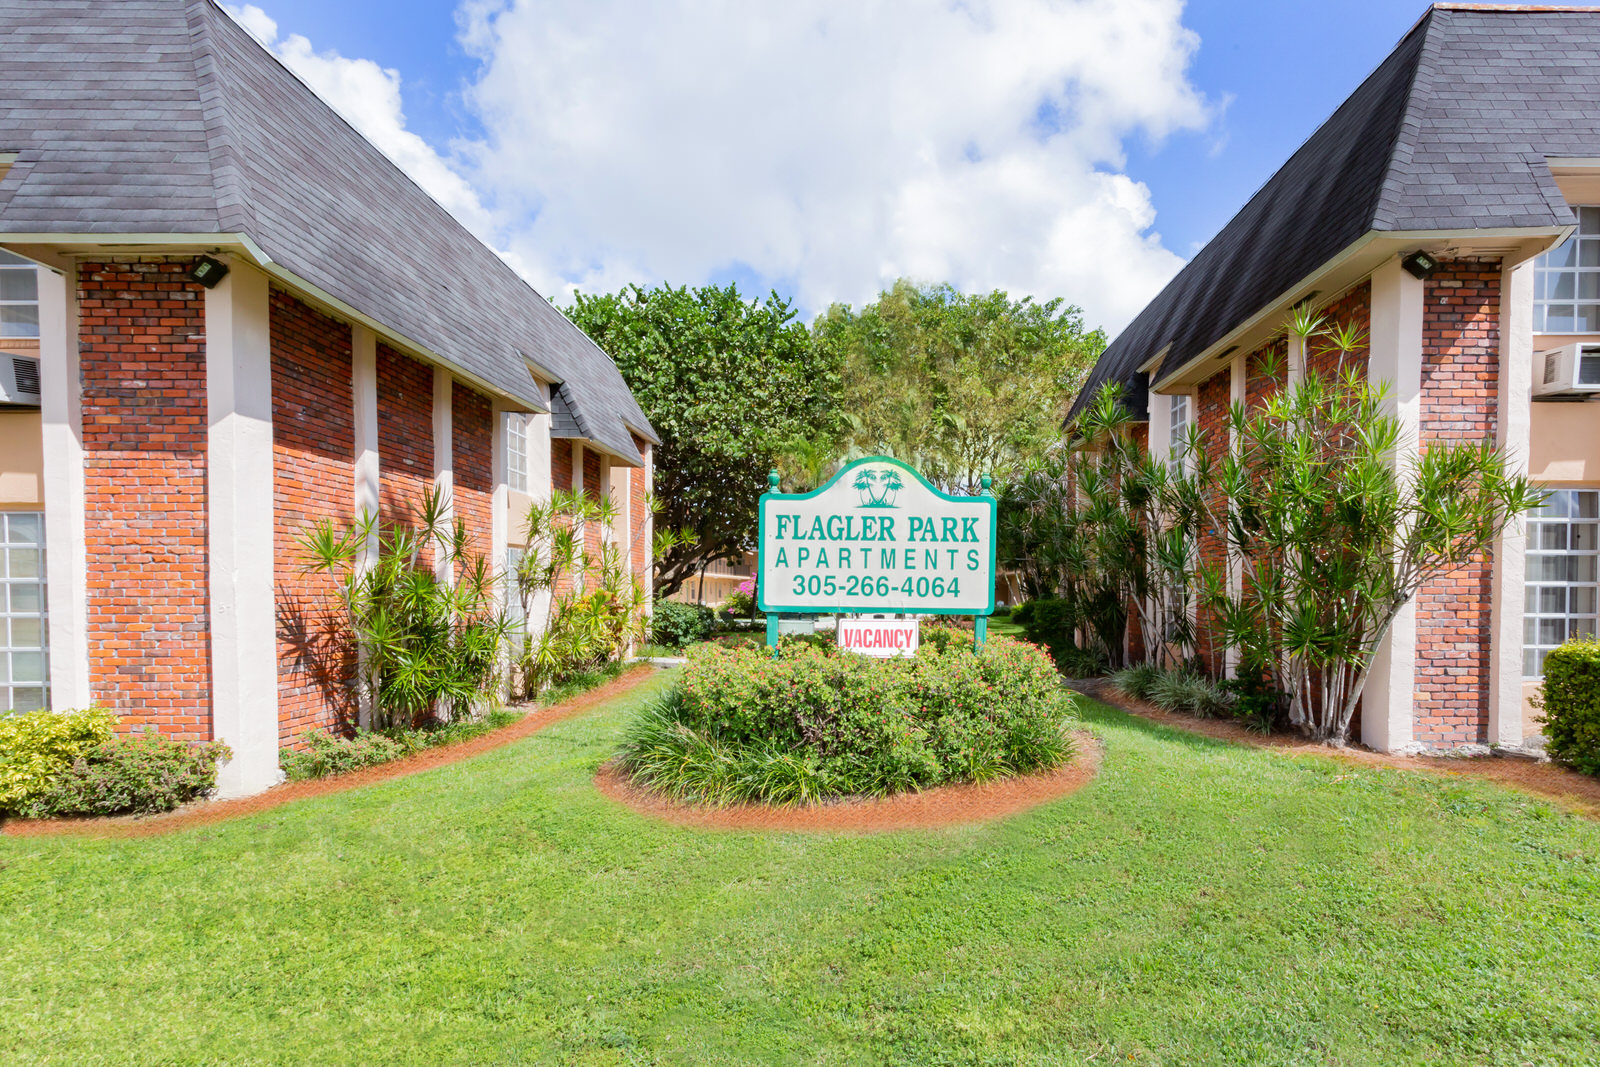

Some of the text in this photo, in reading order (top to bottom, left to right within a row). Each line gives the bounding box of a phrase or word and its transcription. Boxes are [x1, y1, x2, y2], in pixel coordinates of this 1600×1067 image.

[775, 514, 979, 542] FLAGLER PARK
[775, 547, 979, 571] APARTMENTS
[792, 575, 960, 597] 305-266-4064
[843, 628, 913, 648] VACANCY
